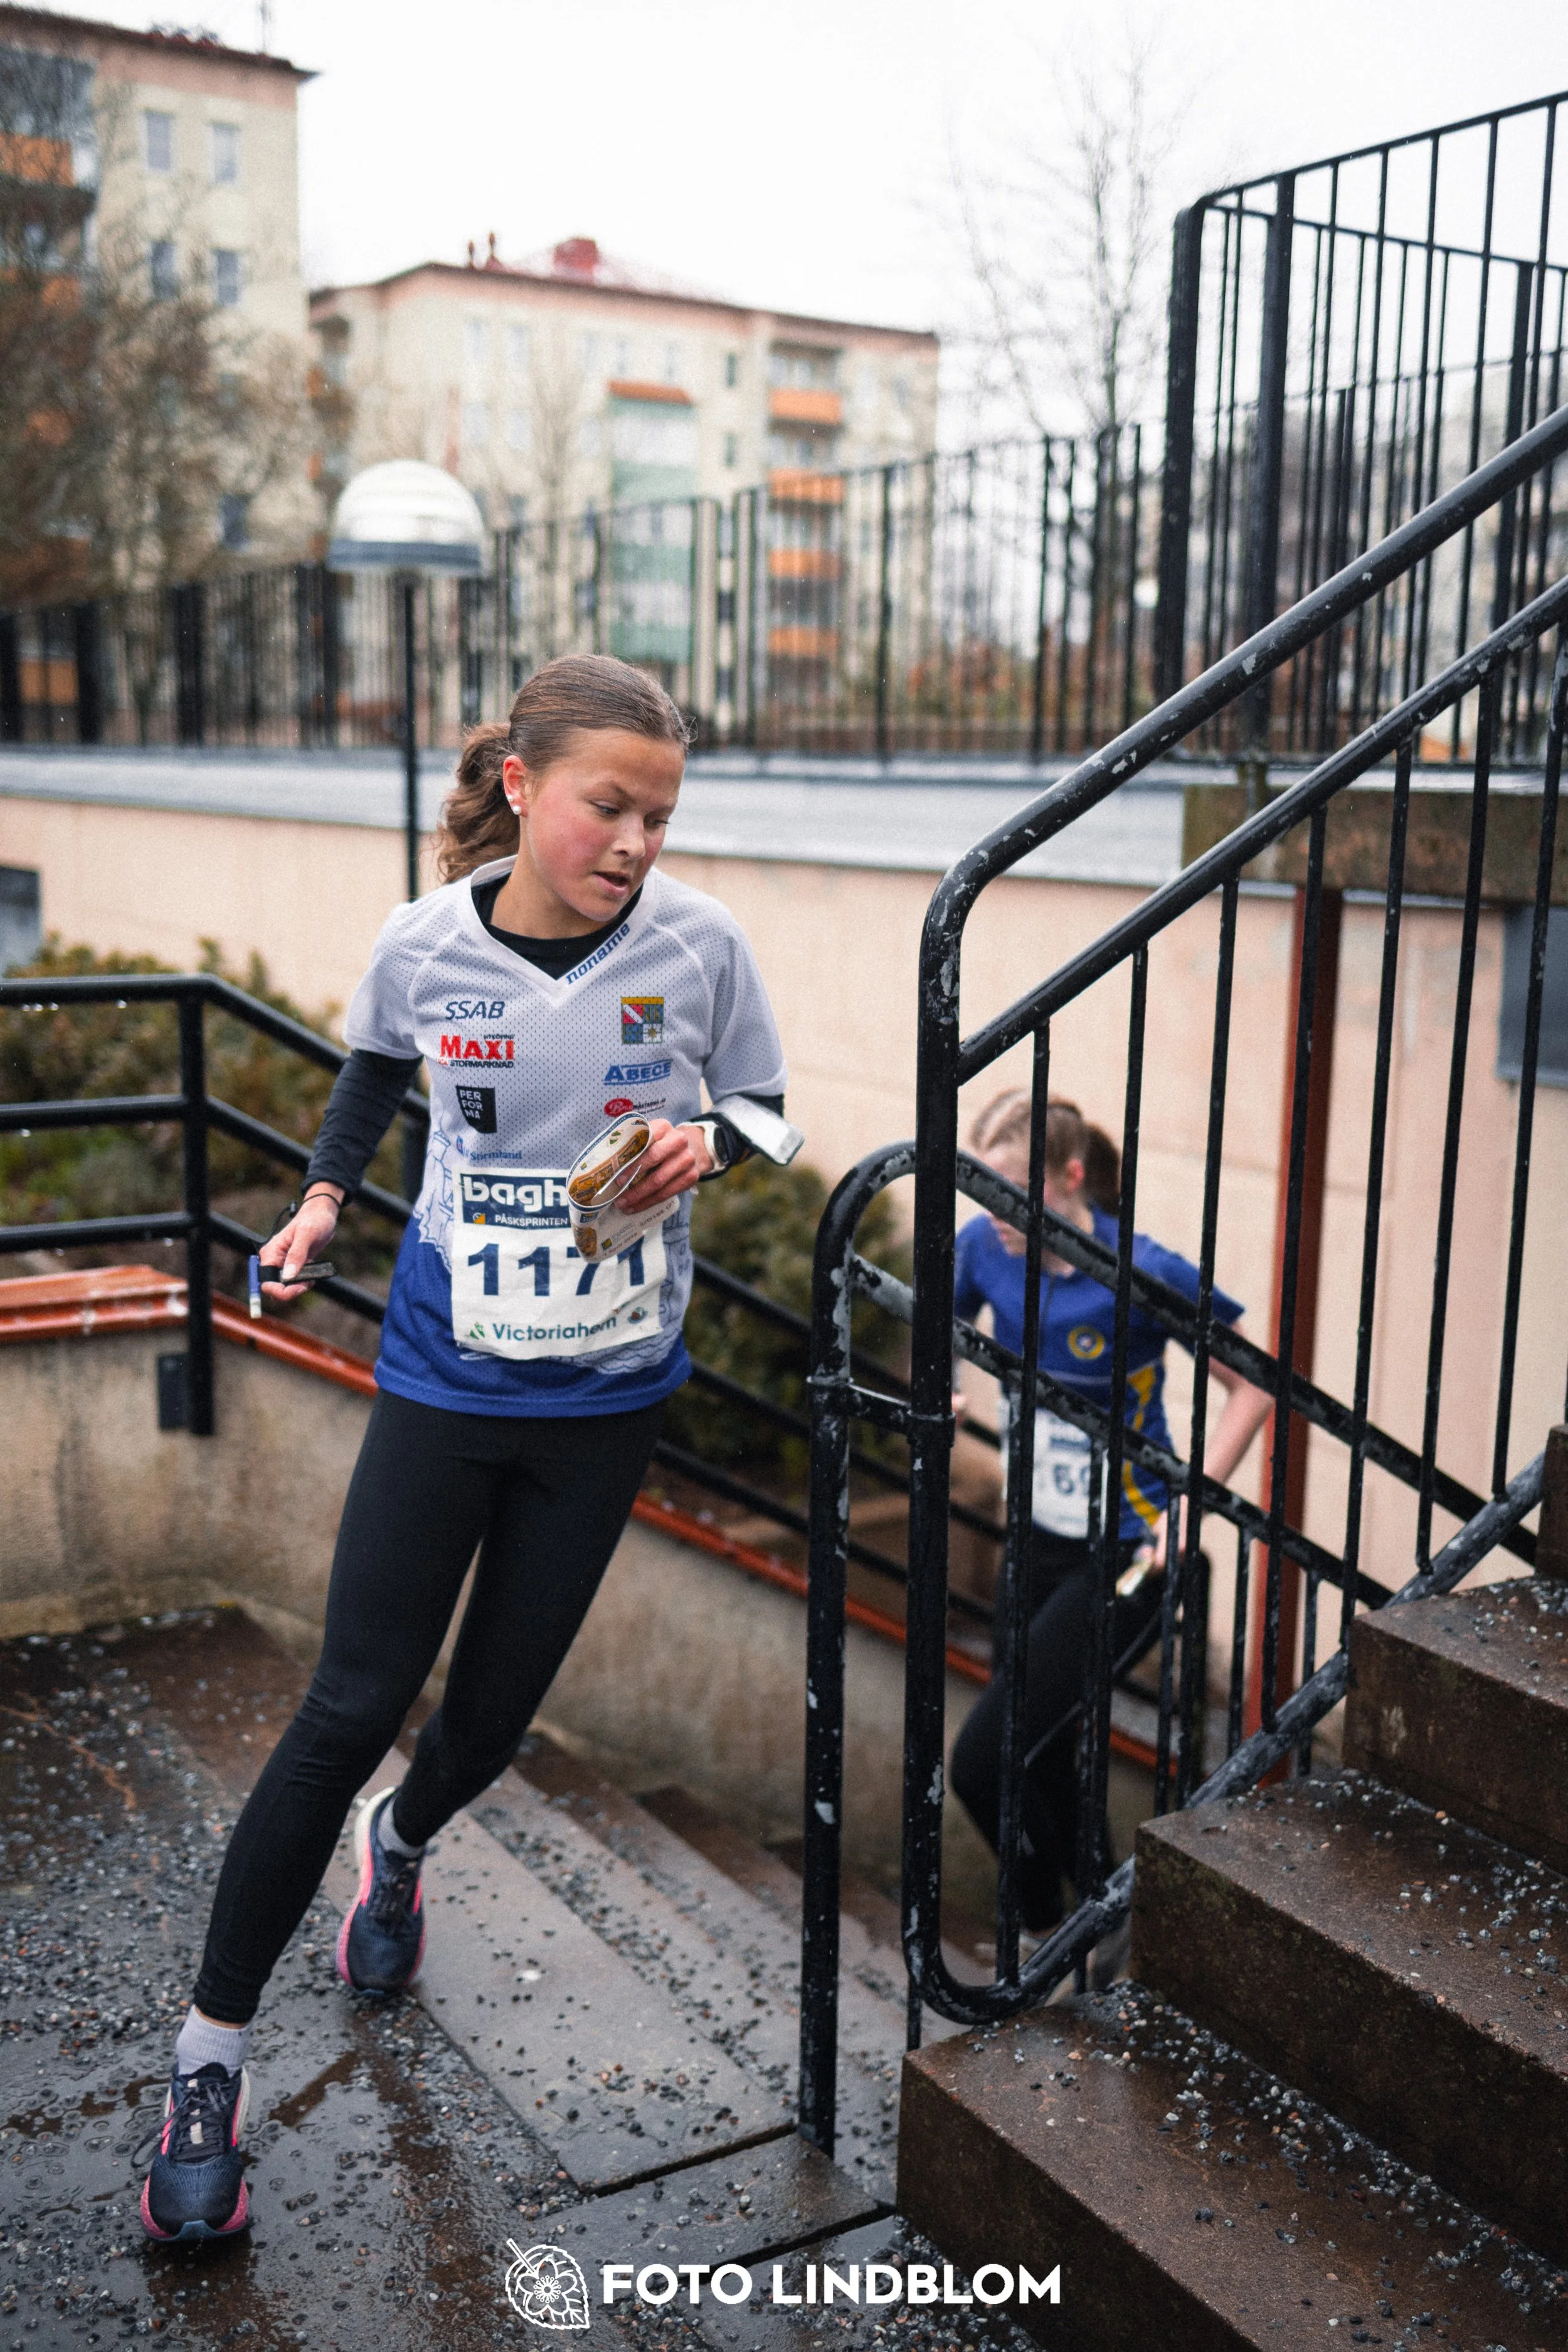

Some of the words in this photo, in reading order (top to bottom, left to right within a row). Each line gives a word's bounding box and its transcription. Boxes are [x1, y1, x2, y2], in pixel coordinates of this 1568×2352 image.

[566, 923, 630, 985] noname
[445, 1000, 506, 1020] SSAB
[440, 1035, 514, 1061] MAXI
[450, 1060, 515, 1069] STORMARKNAD
[604, 1061, 671, 1081] ABECE
[460, 1089, 482, 1101] PER
[462, 1099, 484, 1111] FOR
[464, 1109, 480, 1120] MA
[495, 1213, 568, 1226] PÅSKSPRINTEN
[468, 1236, 645, 1296] 1171
